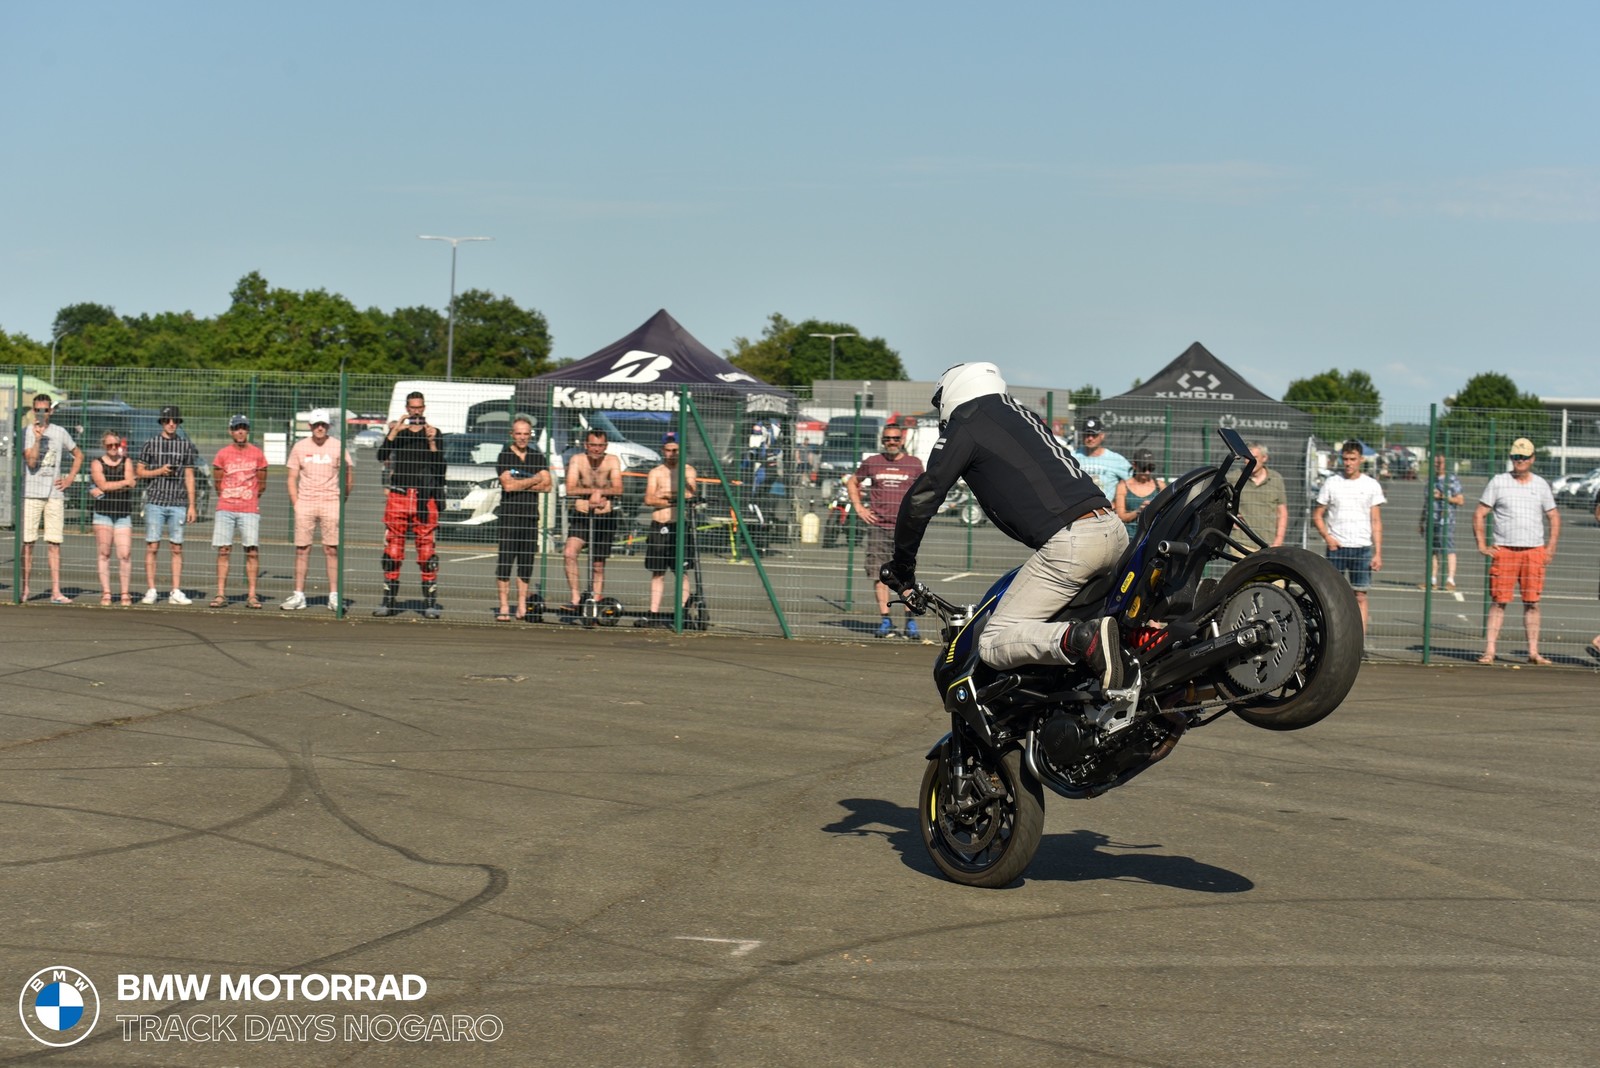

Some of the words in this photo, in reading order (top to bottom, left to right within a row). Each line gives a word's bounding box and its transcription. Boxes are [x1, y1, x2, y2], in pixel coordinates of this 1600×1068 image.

[1155, 391, 1234, 400] XLMOTO
[1239, 418, 1289, 429] XLMOTO
[304, 453, 332, 464] FILA
